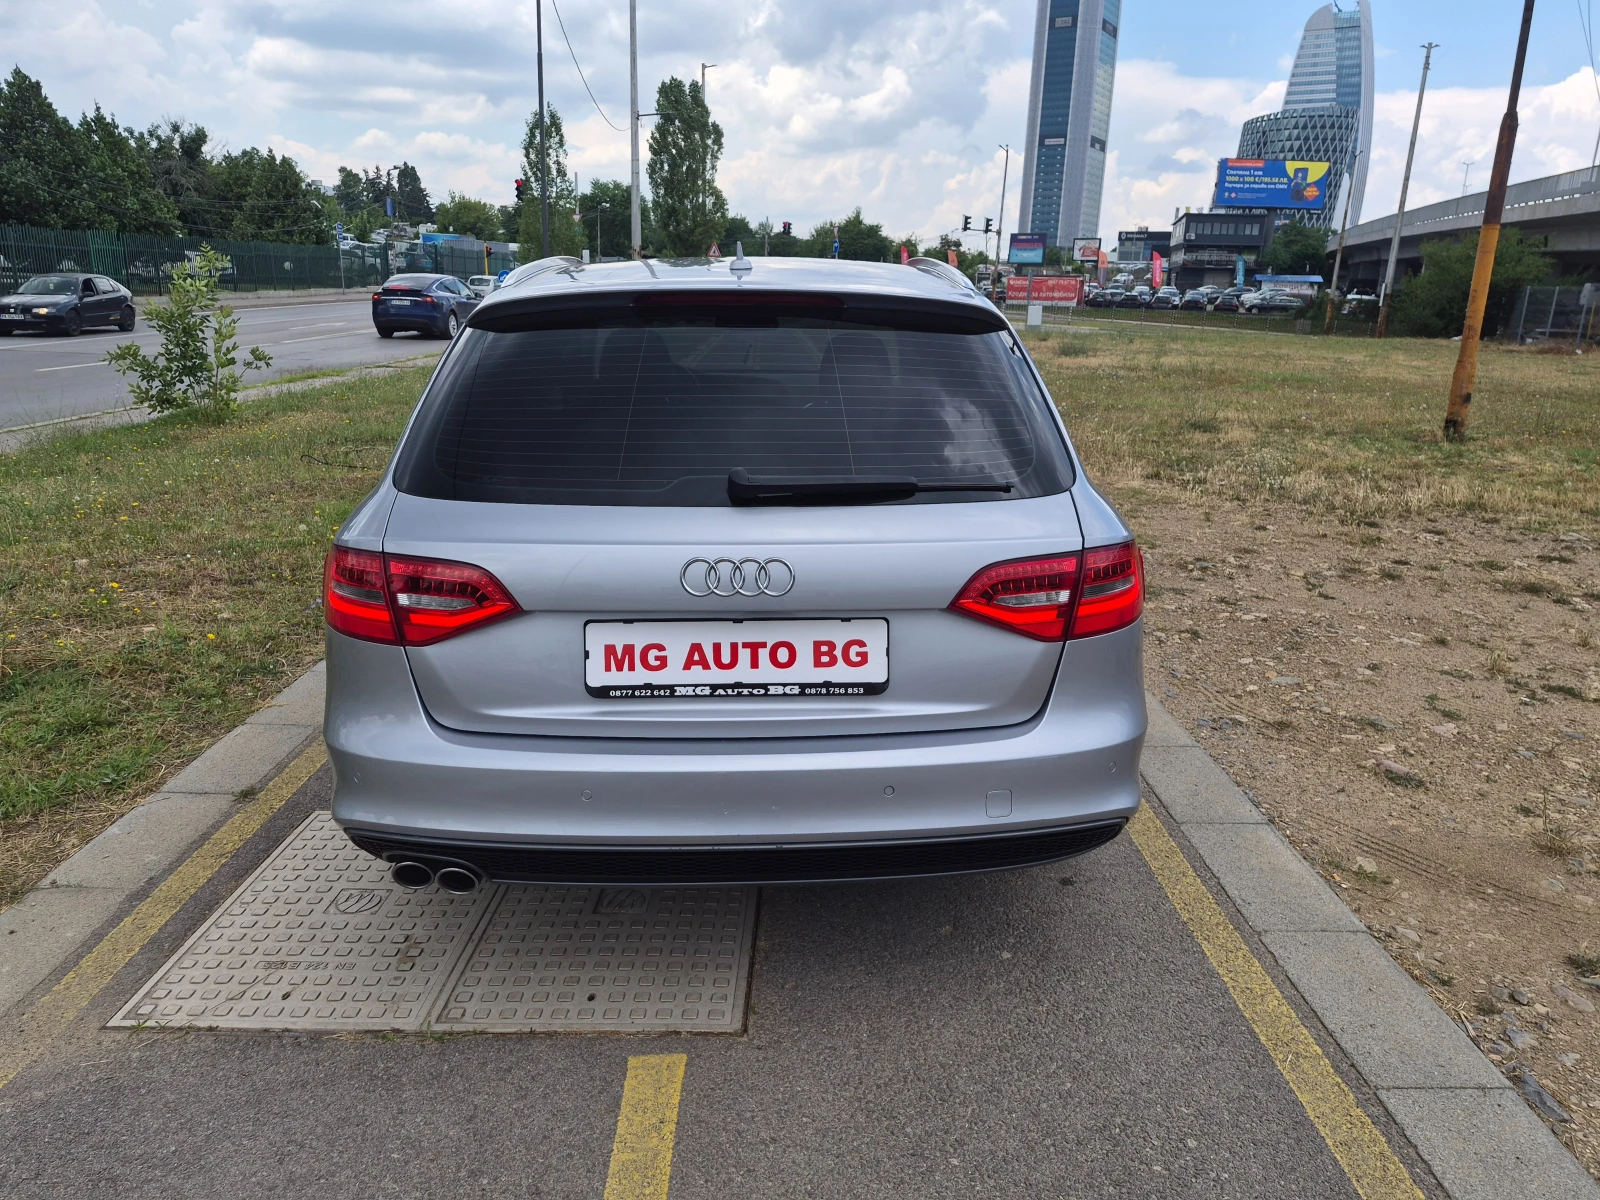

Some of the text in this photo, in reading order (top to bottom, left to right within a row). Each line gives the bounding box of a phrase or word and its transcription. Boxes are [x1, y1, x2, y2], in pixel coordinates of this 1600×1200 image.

[604, 639, 869, 672] MG AUTO BG
[609, 689, 632, 697] 0877
[674, 686, 712, 696] MG
[767, 685, 802, 695] BG
[333, 962, 357, 970] EN
